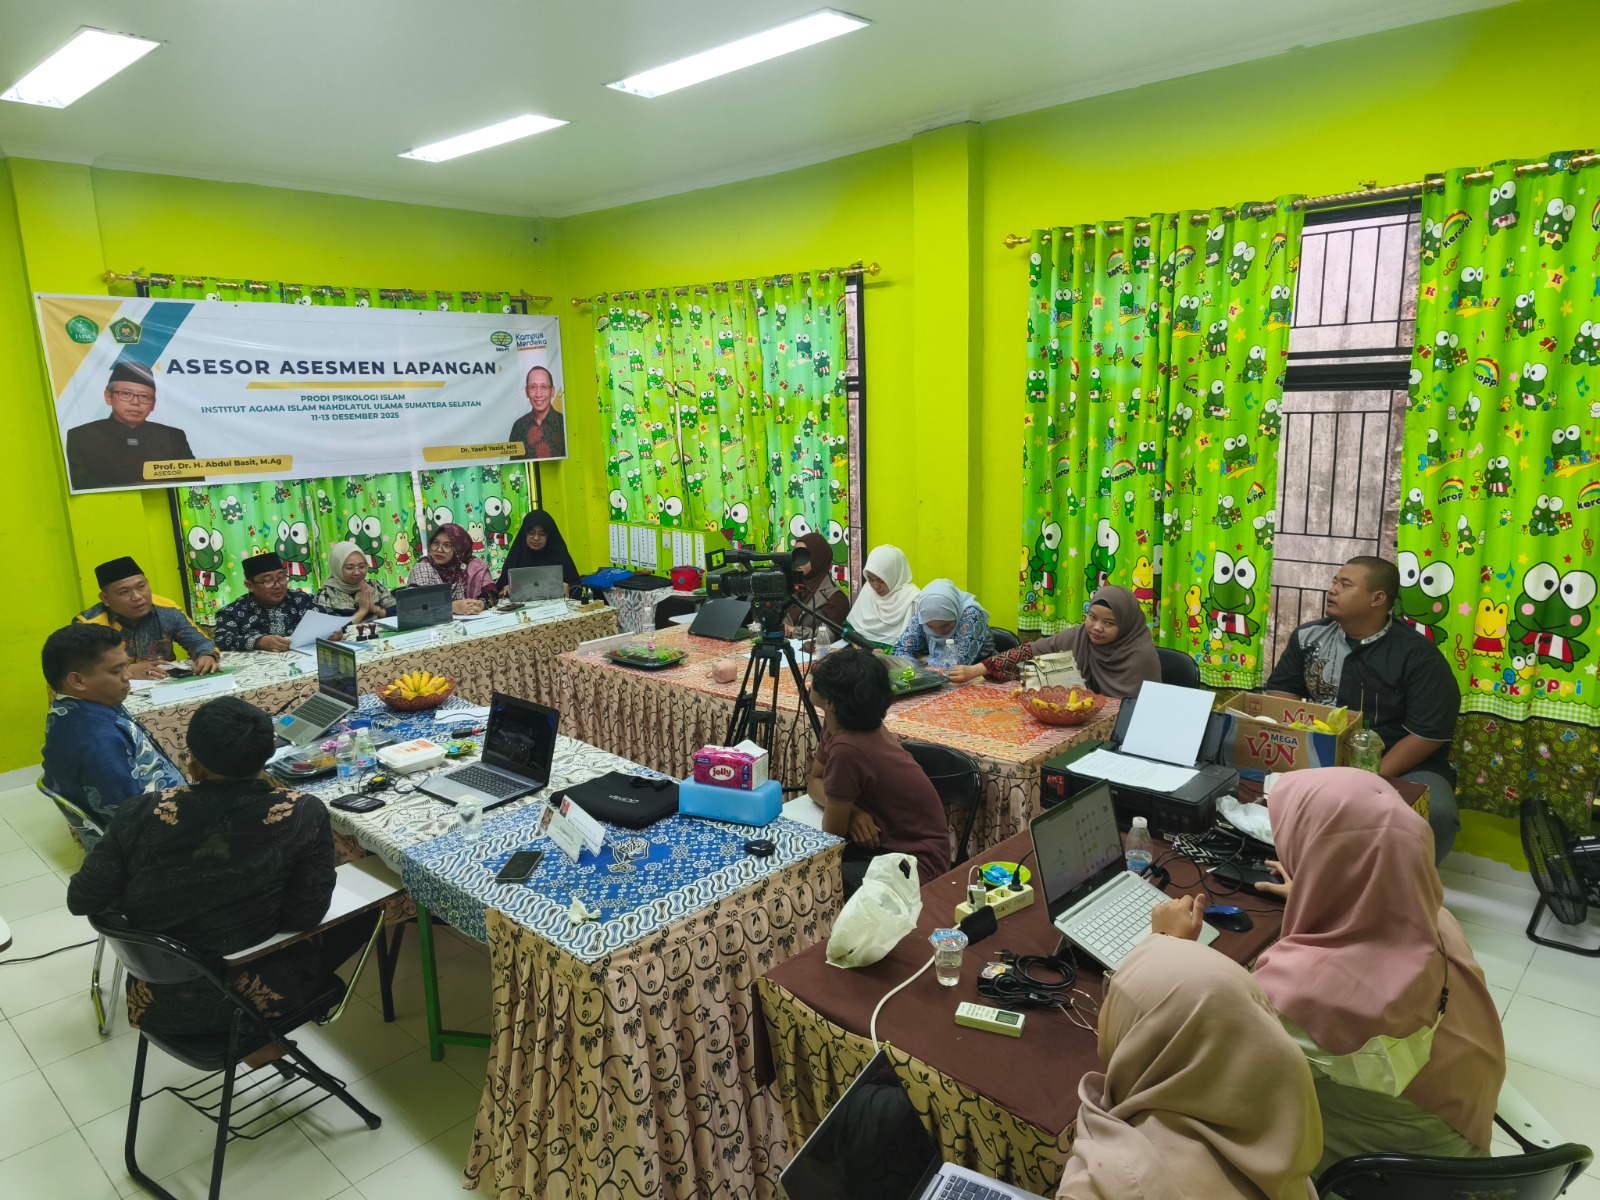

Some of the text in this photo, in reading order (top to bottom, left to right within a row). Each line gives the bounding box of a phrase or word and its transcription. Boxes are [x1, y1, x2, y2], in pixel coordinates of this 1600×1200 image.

[515, 332, 544, 341] Kampus
[516, 339, 548, 348] Merdeka
[166, 359, 496, 375] ASESOR ASESMEN LAPANGAN
[332, 394, 379, 402] PSIKOLOGI
[380, 393, 406, 401] ISLAM
[201, 400, 482, 414] INSTITUT AGAMA ISLAM NAHDLATUL ULAMA SUMATERA SELATAN
[310, 412, 400, 421] 11-13 DESEMBER 2025
[488, 444, 506, 452] Yazid,
[153, 462, 176, 471] Prof.
[205, 460, 232, 468] Abdul
[234, 459, 259, 468] Basit,
[260, 458, 282, 466] M.Ag
[1270, 733, 1298, 745] MEGA
[712, 767, 732, 777] jolly
